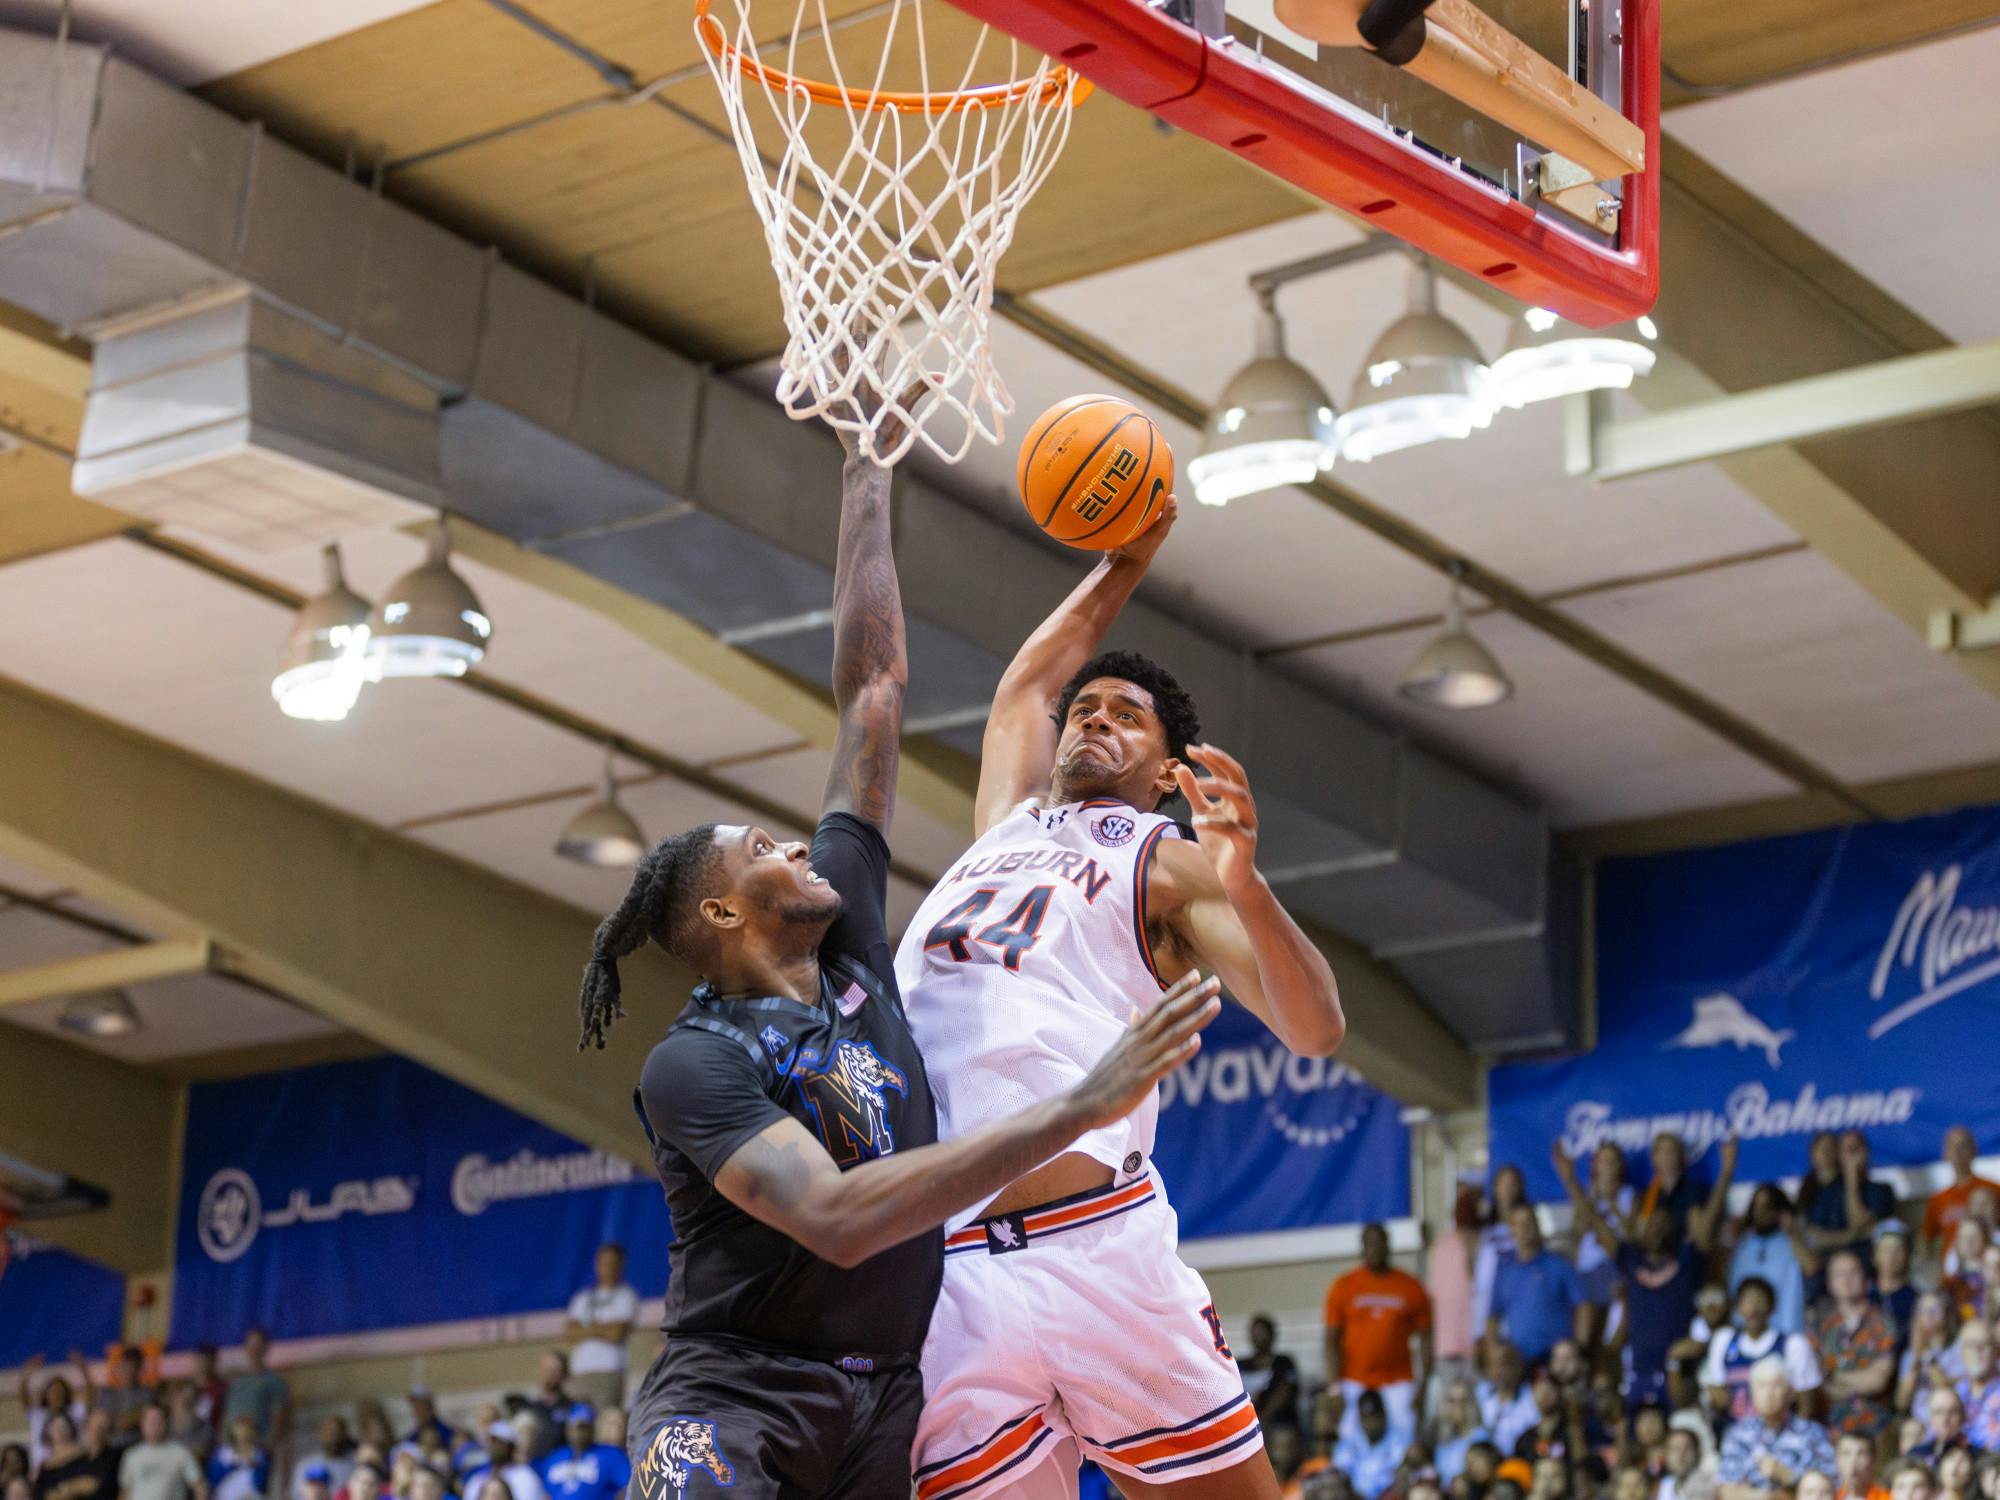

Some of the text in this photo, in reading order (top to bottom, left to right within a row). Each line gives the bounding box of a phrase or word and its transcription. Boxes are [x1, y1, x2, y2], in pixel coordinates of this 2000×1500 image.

[1076, 447, 1138, 522] ELITE
[1101, 816, 1133, 839] SEC
[936, 849, 1112, 905] AUBURN
[924, 885, 1057, 971] 44
[1560, 1081, 1914, 1164] Tommy Bahama
